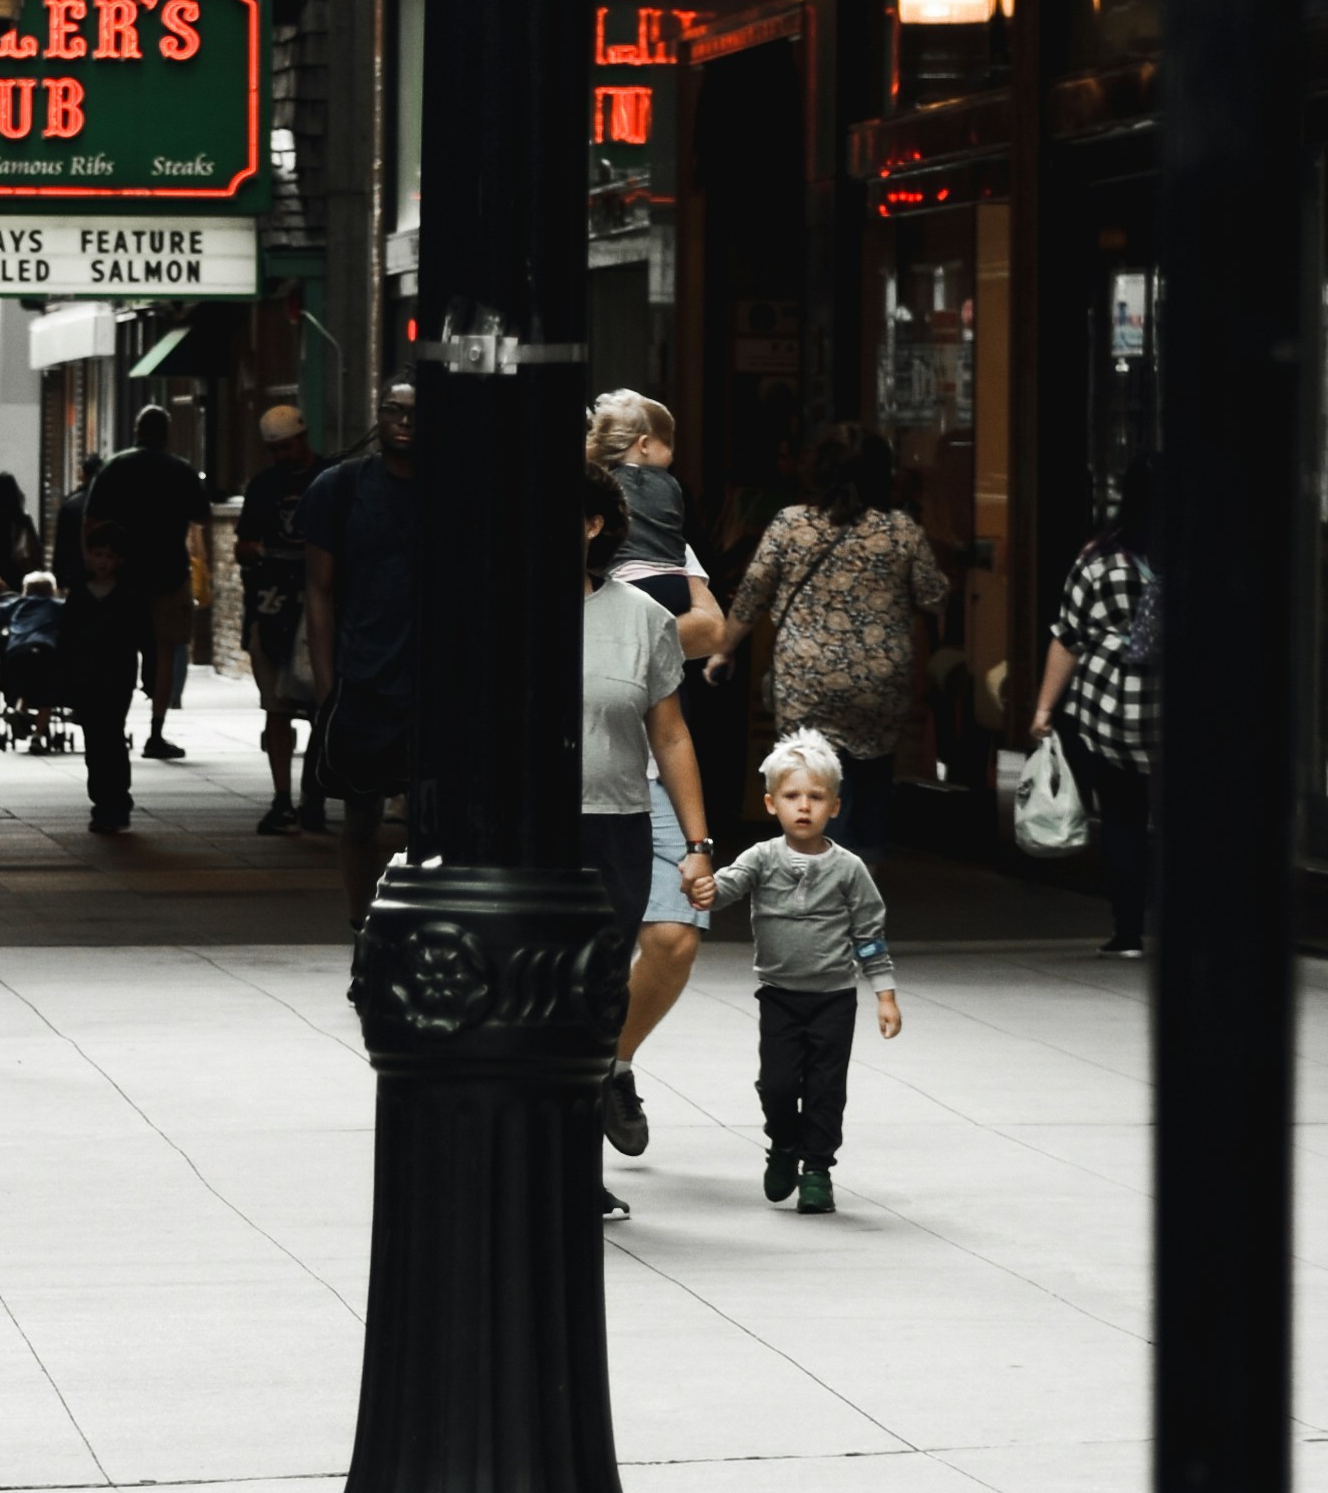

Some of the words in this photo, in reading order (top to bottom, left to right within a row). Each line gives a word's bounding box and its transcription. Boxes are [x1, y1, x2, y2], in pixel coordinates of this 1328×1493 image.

[70, 154, 115, 176] Ribs
[151, 154, 214, 177] Steaks
[80, 229, 204, 255] FEATURE
[90, 259, 202, 283] SALMON
